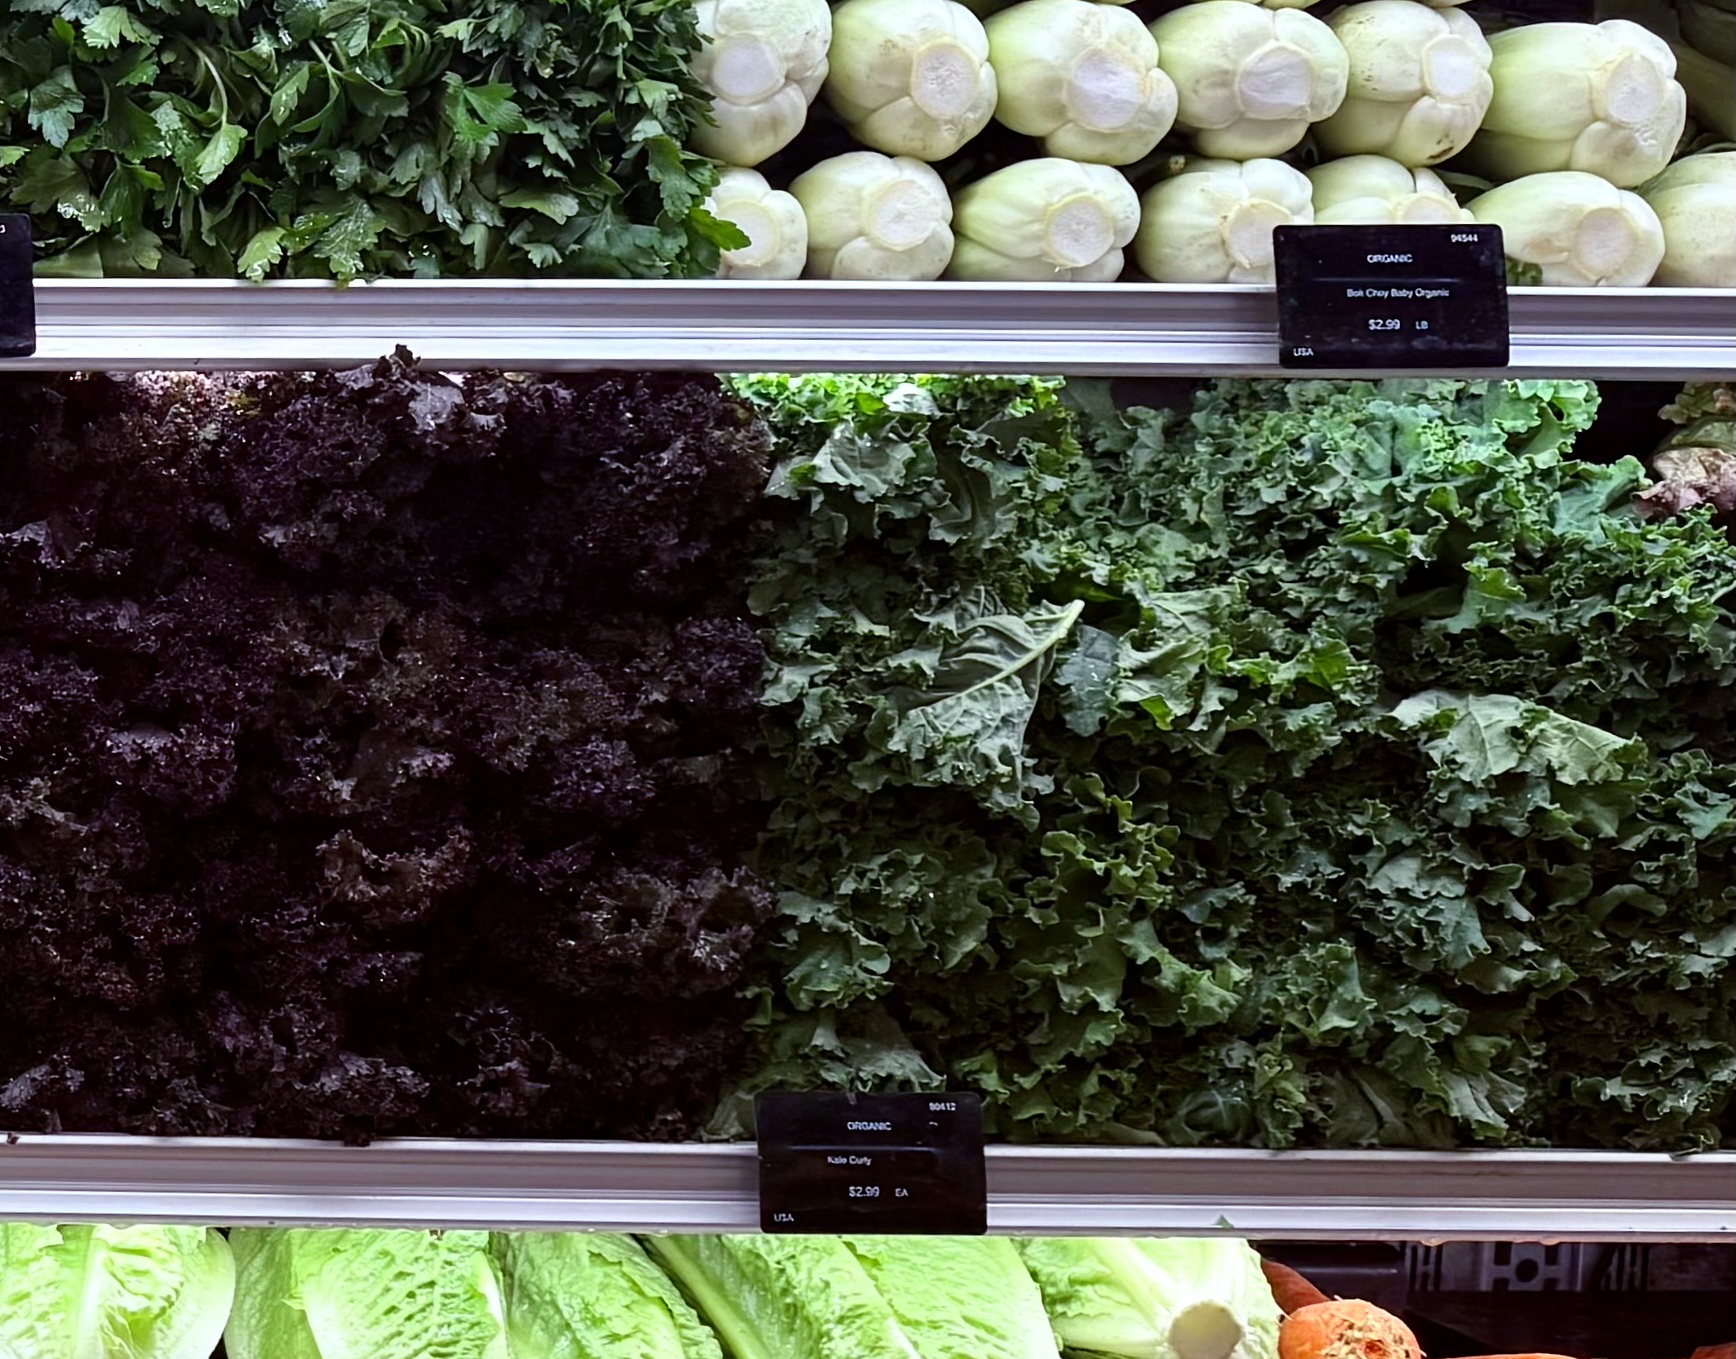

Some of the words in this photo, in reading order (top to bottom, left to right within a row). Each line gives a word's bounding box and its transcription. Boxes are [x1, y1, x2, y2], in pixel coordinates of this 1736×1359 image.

[1367, 254, 1412, 263] ORGANIC
[1366, 289, 1389, 298] Choy
[1391, 289, 1413, 298] Baby
[1415, 288, 1449, 299] Organic
[1368, 319, 1400, 330] $2.99
[1416, 321, 1428, 329] LB
[1294, 348, 1313, 356] USA
[847, 1122, 891, 1131] ORGANIC
[828, 1156, 847, 1164] Kale
[849, 1156, 872, 1166] Curly
[849, 1186, 879, 1197] $2.99
[895, 1188, 908, 1197] EA
[774, 1214, 794, 1222] USA
